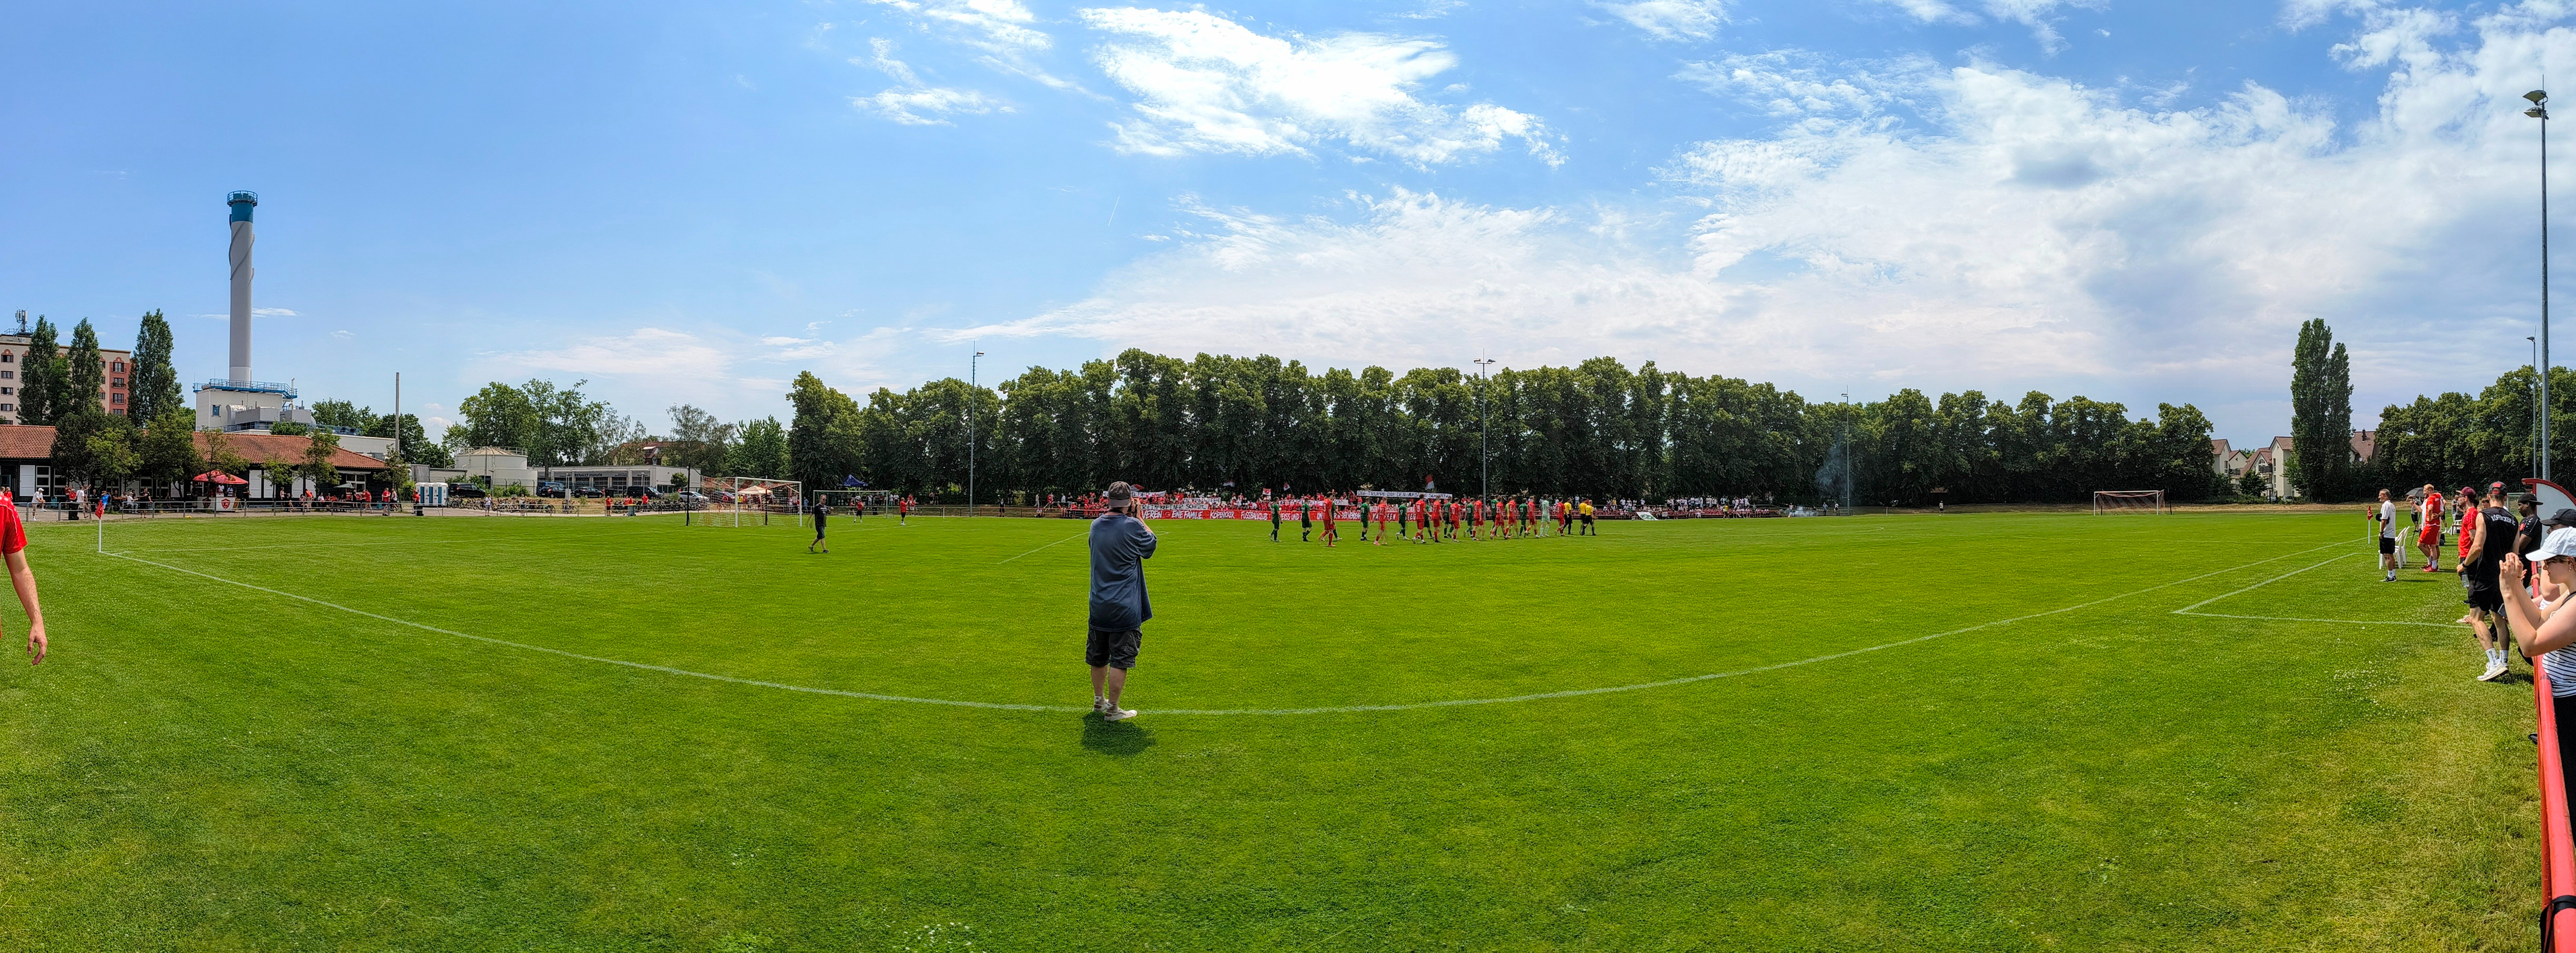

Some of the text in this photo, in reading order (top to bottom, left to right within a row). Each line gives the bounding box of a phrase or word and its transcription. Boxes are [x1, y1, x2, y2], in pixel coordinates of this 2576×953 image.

[1142, 510, 1162, 519] VEREIN
[1172, 510, 1183, 519] EINE
[1184, 510, 1203, 519] FAMILIE
[1241, 511, 1268, 520] FUSSBALLCLUB
